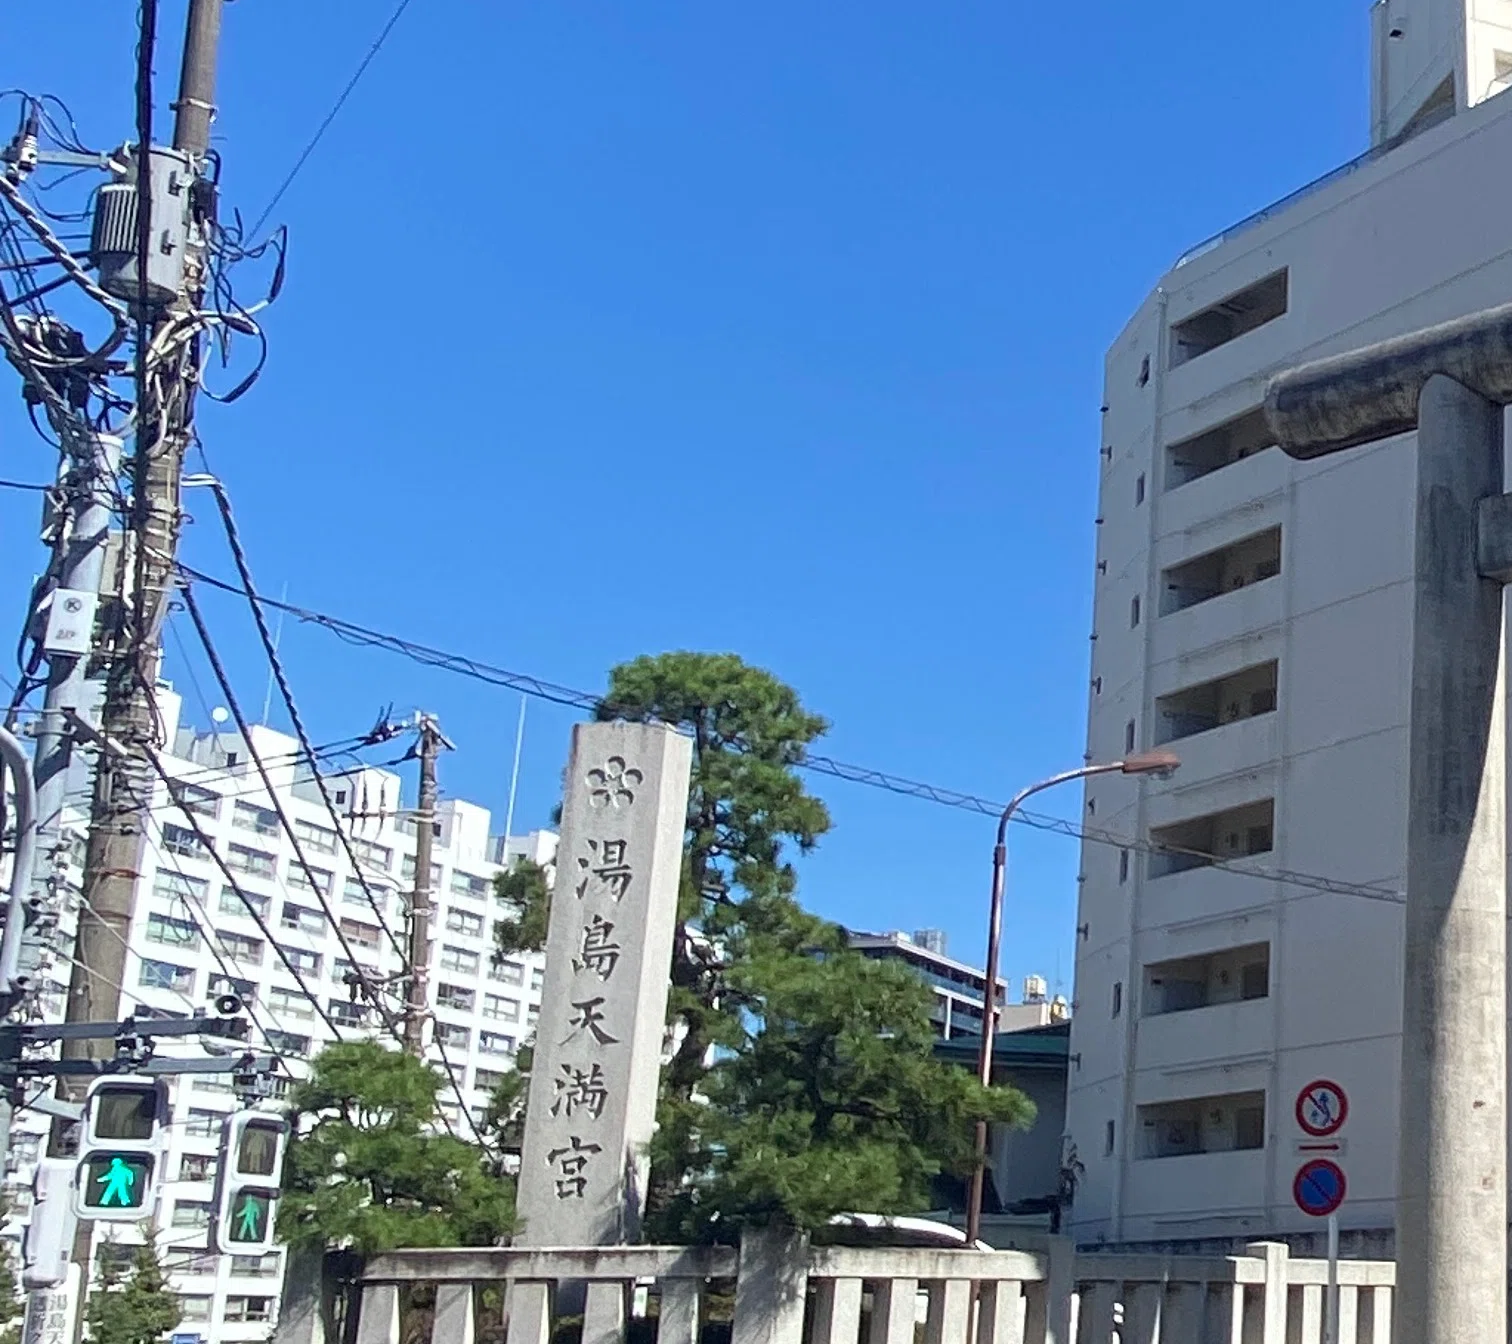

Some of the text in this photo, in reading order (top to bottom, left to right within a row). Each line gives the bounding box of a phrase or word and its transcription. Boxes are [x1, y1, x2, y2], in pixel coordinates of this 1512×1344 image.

[546, 839, 634, 1201] 湯島天満宮
